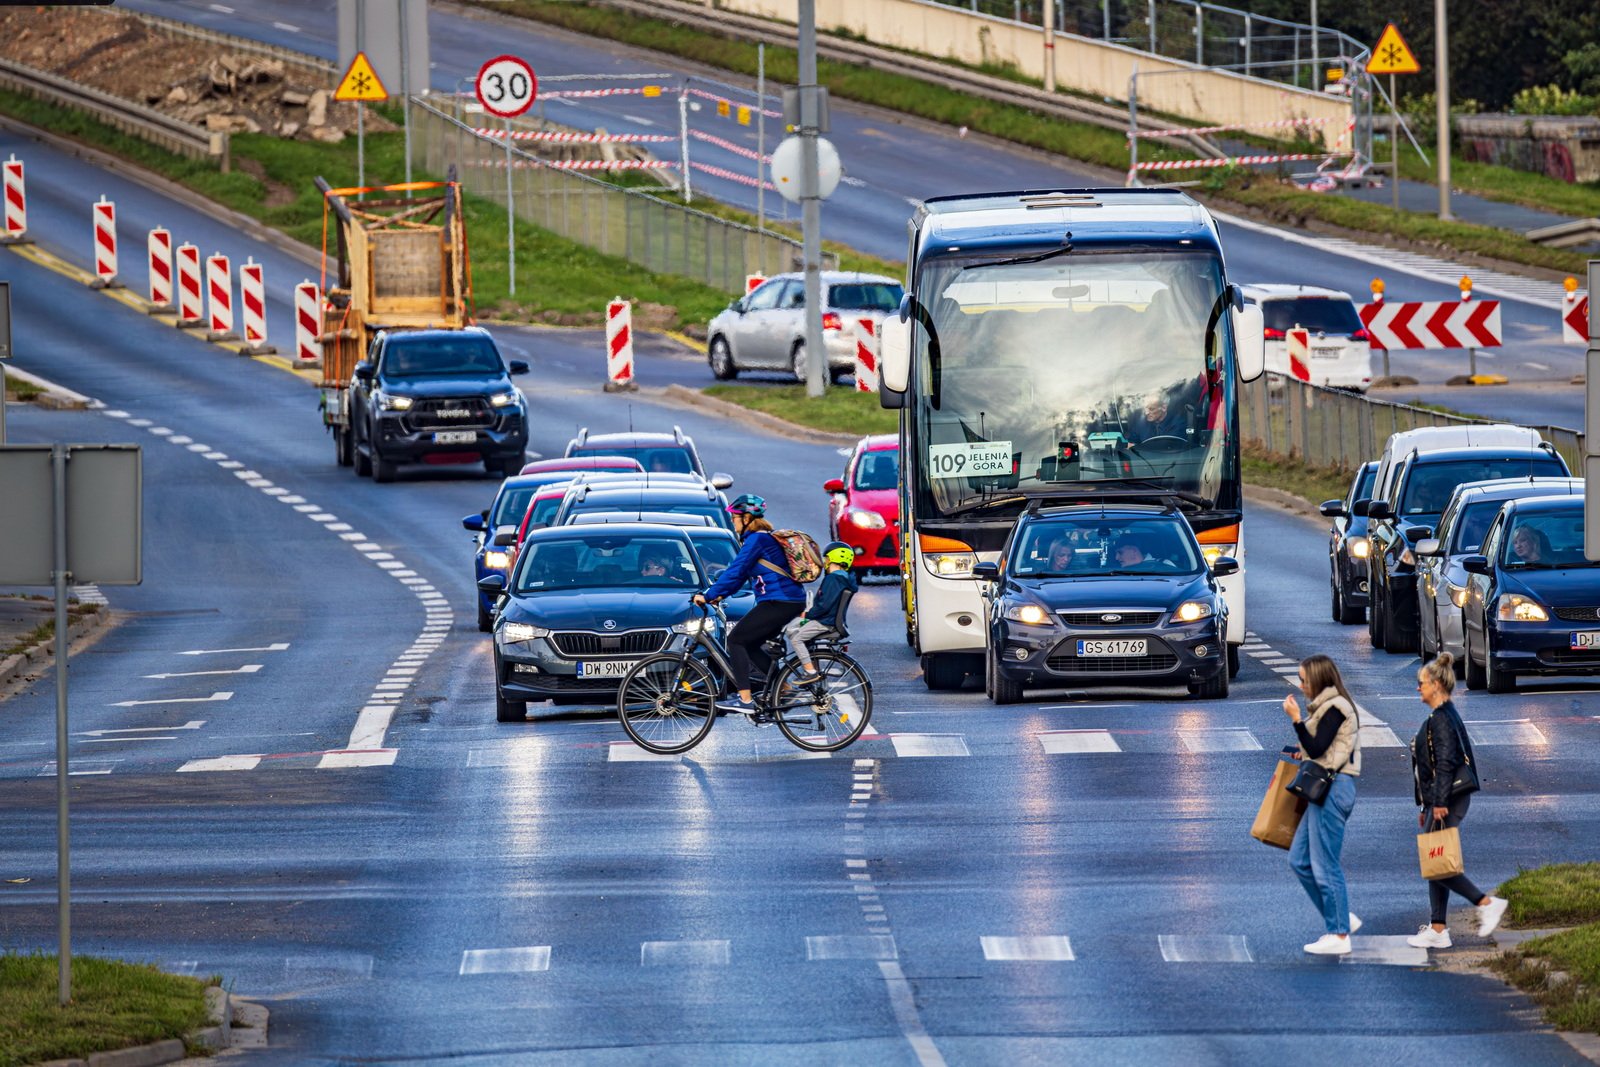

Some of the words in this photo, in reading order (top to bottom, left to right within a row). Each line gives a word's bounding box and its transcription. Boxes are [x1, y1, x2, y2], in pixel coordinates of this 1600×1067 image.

[487, 72, 528, 102] 30
[932, 453, 967, 473] 109
[967, 452, 1009, 462] JELENIA
[973, 460, 1004, 471] GÓRA
[1085, 641, 1103, 654] GS
[1107, 640, 1145, 654] 61769
[585, 662, 601, 675] DW
